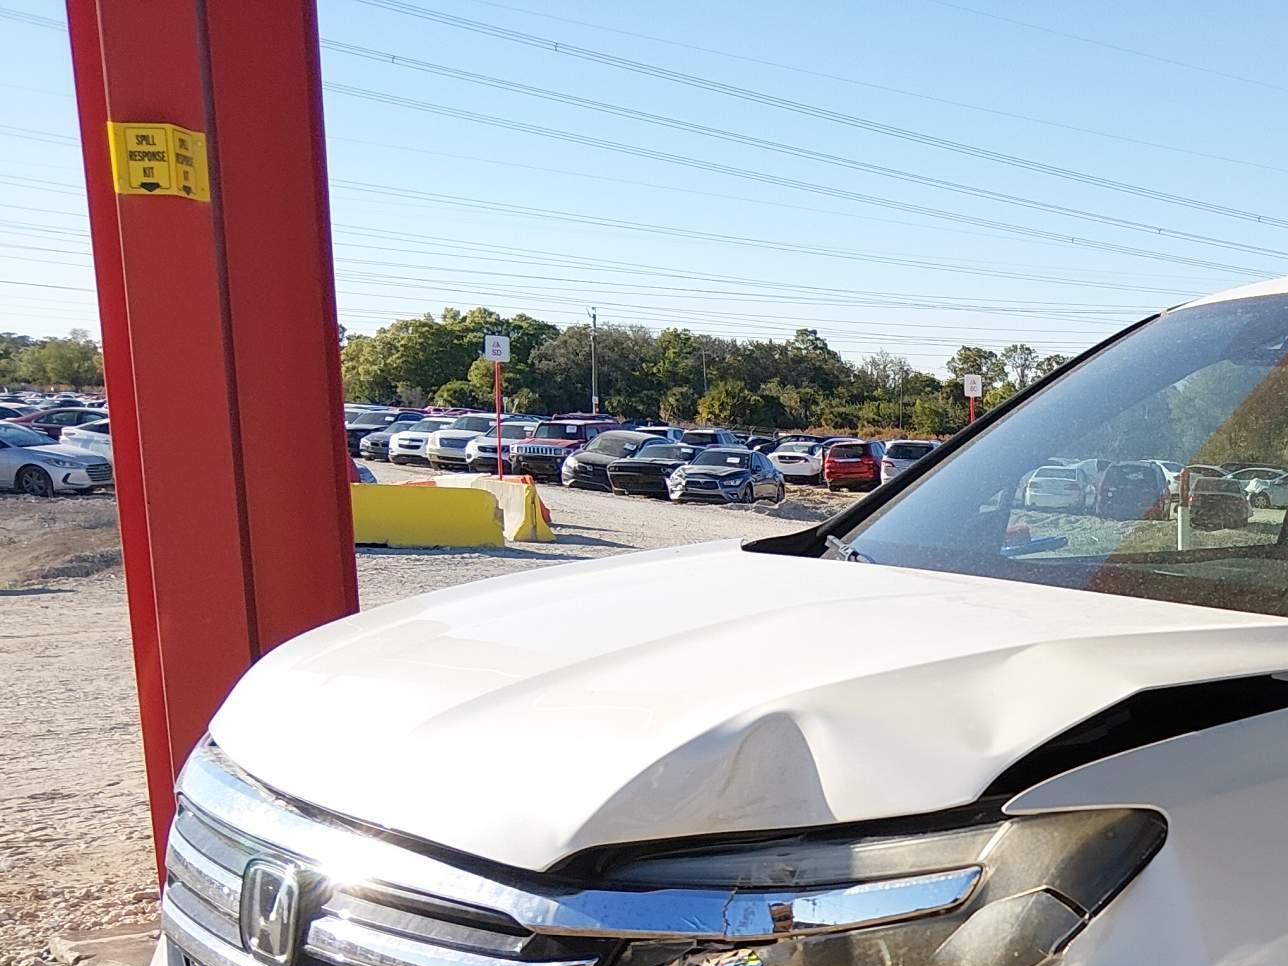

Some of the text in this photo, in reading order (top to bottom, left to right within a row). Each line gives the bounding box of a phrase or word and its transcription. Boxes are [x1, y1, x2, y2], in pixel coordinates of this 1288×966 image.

[135, 134, 156, 146] SPILL
[128, 150, 167, 162] RESPONSE
[142, 166, 154, 178] KIT
